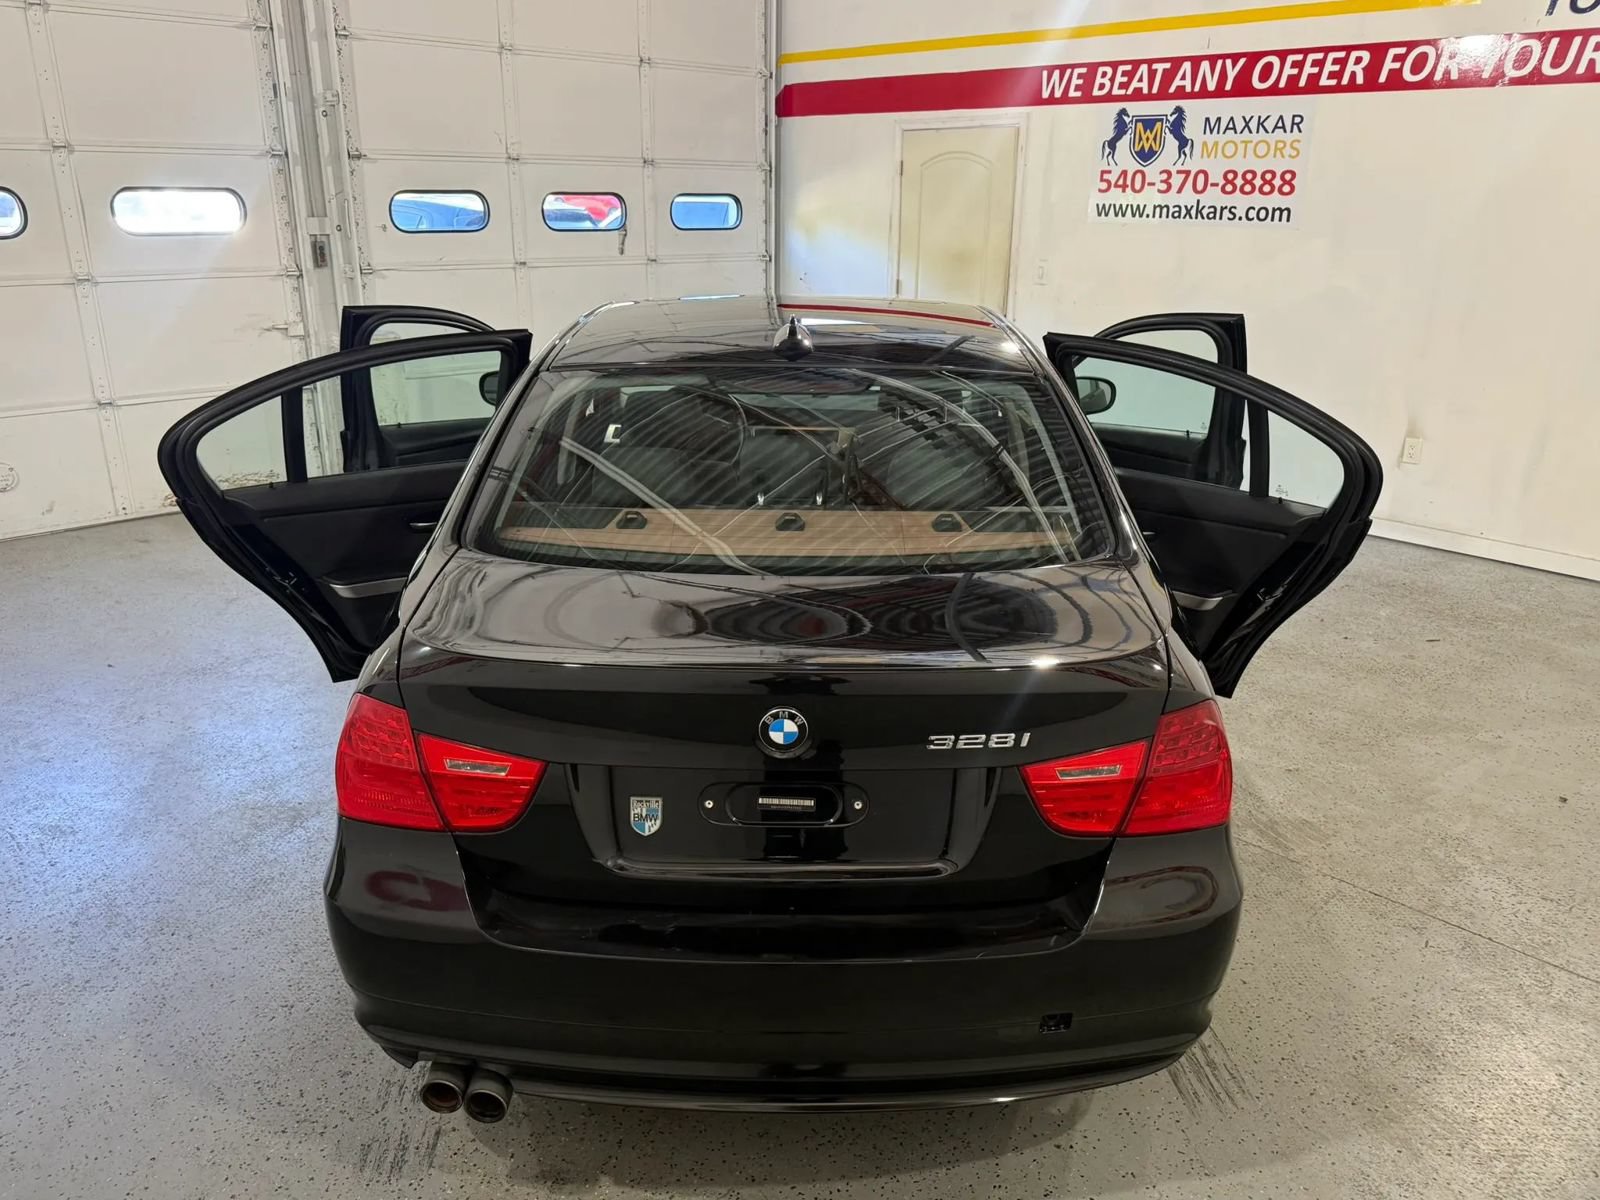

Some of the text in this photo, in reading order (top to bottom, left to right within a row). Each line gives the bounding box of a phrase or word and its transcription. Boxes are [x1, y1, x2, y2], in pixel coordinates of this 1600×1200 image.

[1041, 67, 1087, 99] WE
[1091, 62, 1172, 97] BEAT
[1168, 57, 1246, 93] ANY
[1251, 49, 1370, 90] OFFER
[1378, 40, 1461, 83] FOR
[1202, 114, 1305, 136] MAXKAR
[1200, 139, 1302, 160] MOTORS
[1097, 168, 1297, 197] 540-370-8888
[1095, 199, 1292, 223] www.maxkars.com
[764, 711, 804, 725] BMW
[633, 812, 659, 823] BMW
